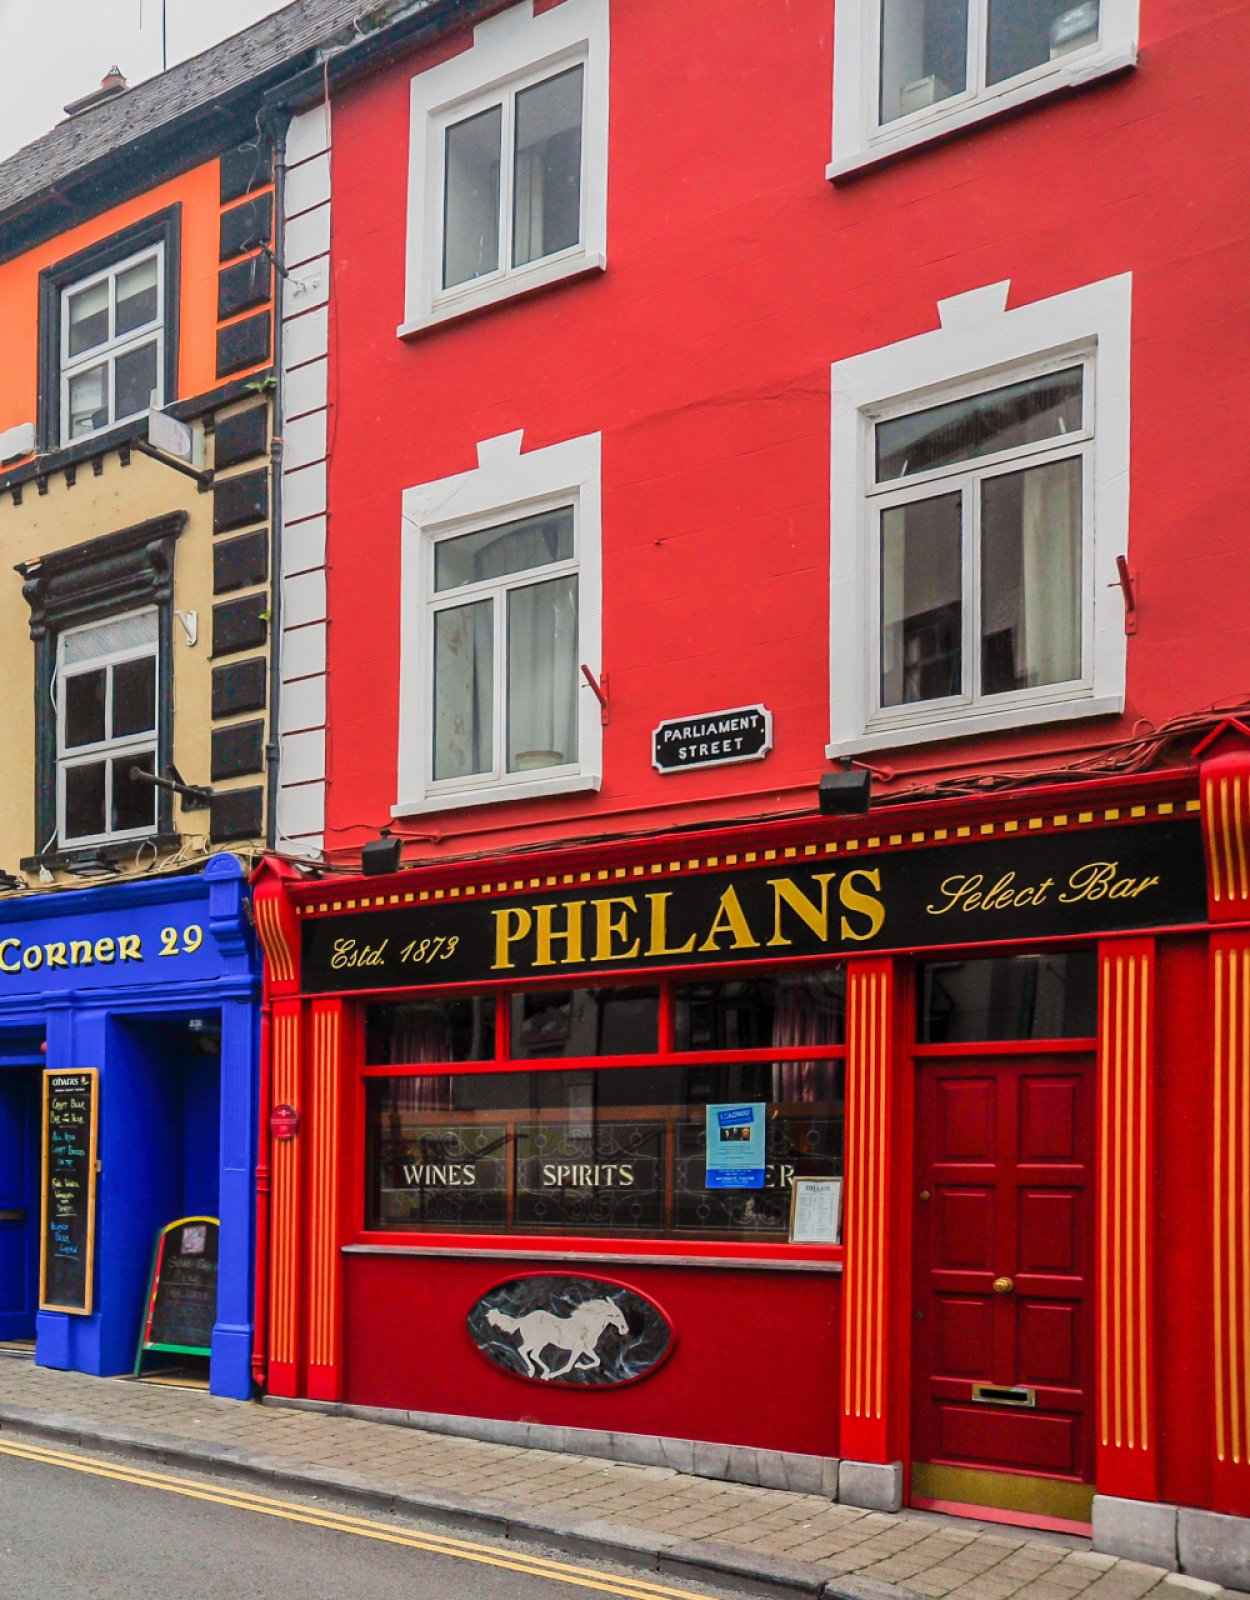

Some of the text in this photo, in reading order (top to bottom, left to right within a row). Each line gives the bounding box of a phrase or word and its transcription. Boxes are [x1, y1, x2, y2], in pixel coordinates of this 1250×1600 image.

[664, 715, 759, 742] PARLIAMENT
[679, 737, 743, 760] STREET
[331, 861, 1160, 970] Estd. 1873 PHELANS Select Bar
[158, 924, 203, 957] 29
[403, 1165, 476, 1186] WINES
[543, 1164, 634, 1186] SPIRITS
